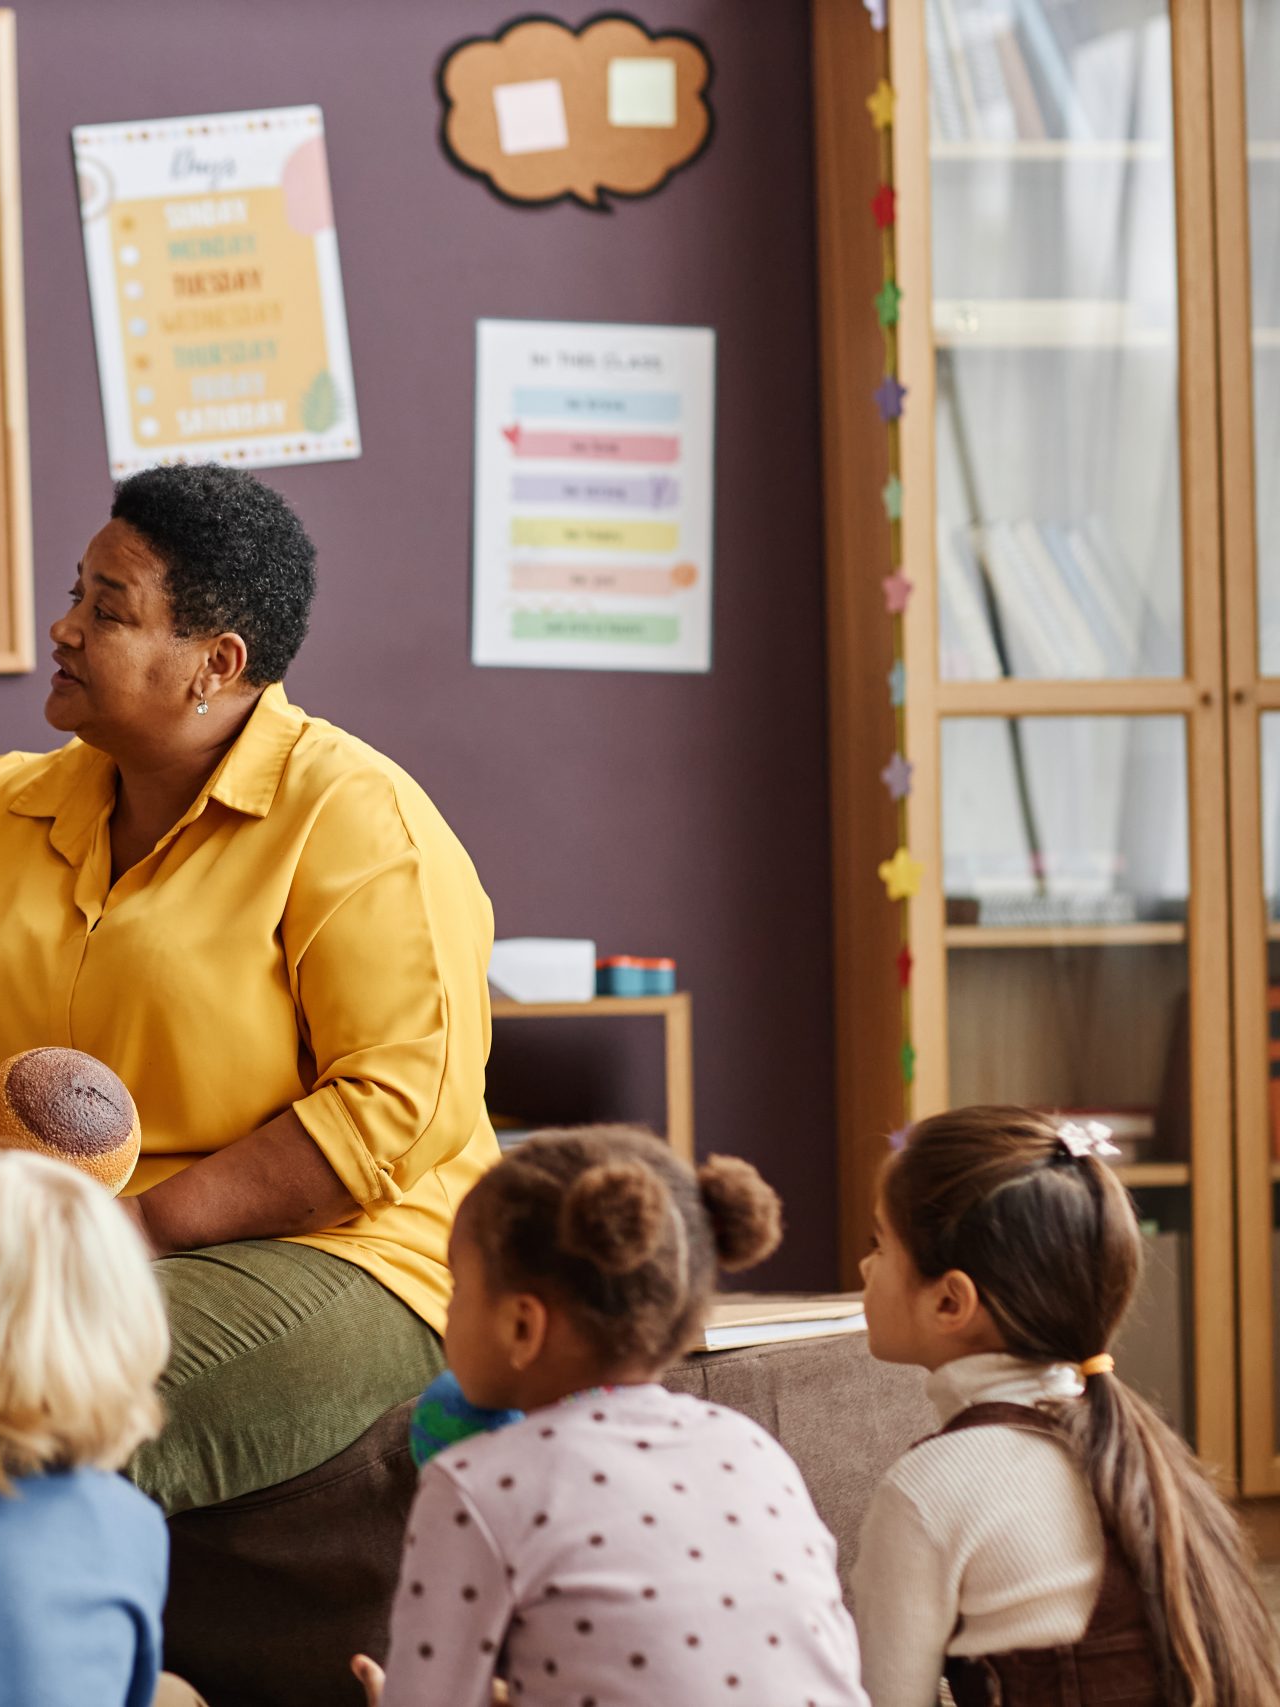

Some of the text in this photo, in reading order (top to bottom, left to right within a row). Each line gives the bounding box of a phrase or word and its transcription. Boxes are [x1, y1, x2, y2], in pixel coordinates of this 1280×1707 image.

[164, 198, 248, 229] SUNDAY
[167, 234, 257, 260] MONDAY
[172, 269, 263, 298] TUESDAY
[158, 302, 284, 334] WEDNESDAY
[173, 340, 278, 369] THURSDAY
[176, 402, 287, 436] SATURDAY
